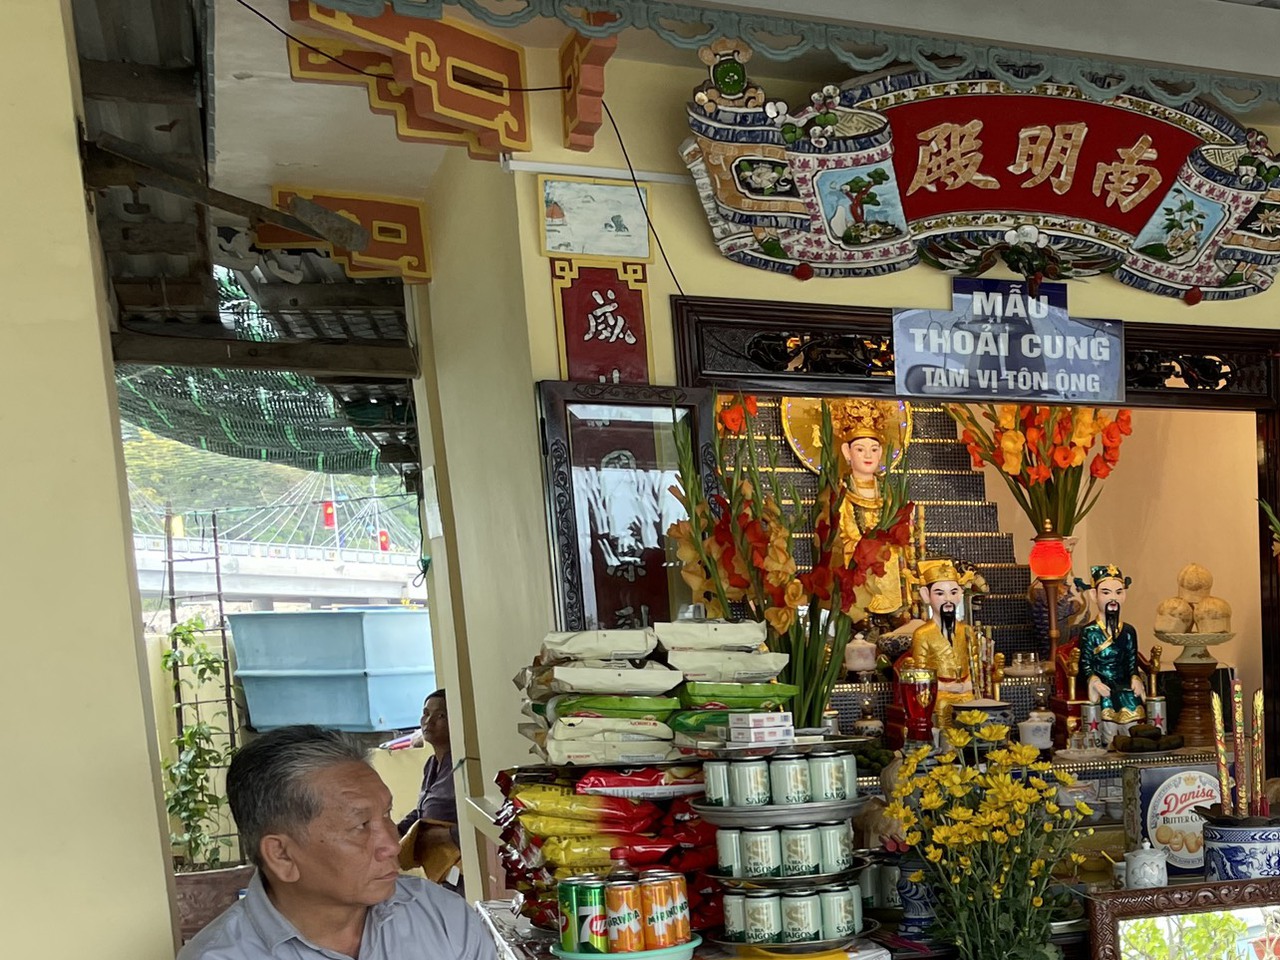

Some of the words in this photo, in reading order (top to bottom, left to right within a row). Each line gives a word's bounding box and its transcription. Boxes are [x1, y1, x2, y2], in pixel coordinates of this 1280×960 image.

[1021, 334, 1110, 361] CUNG
[976, 371, 998, 393] VỊ
[1002, 367, 1048, 391] TÔN
[1160, 785, 1217, 816] Danisa
